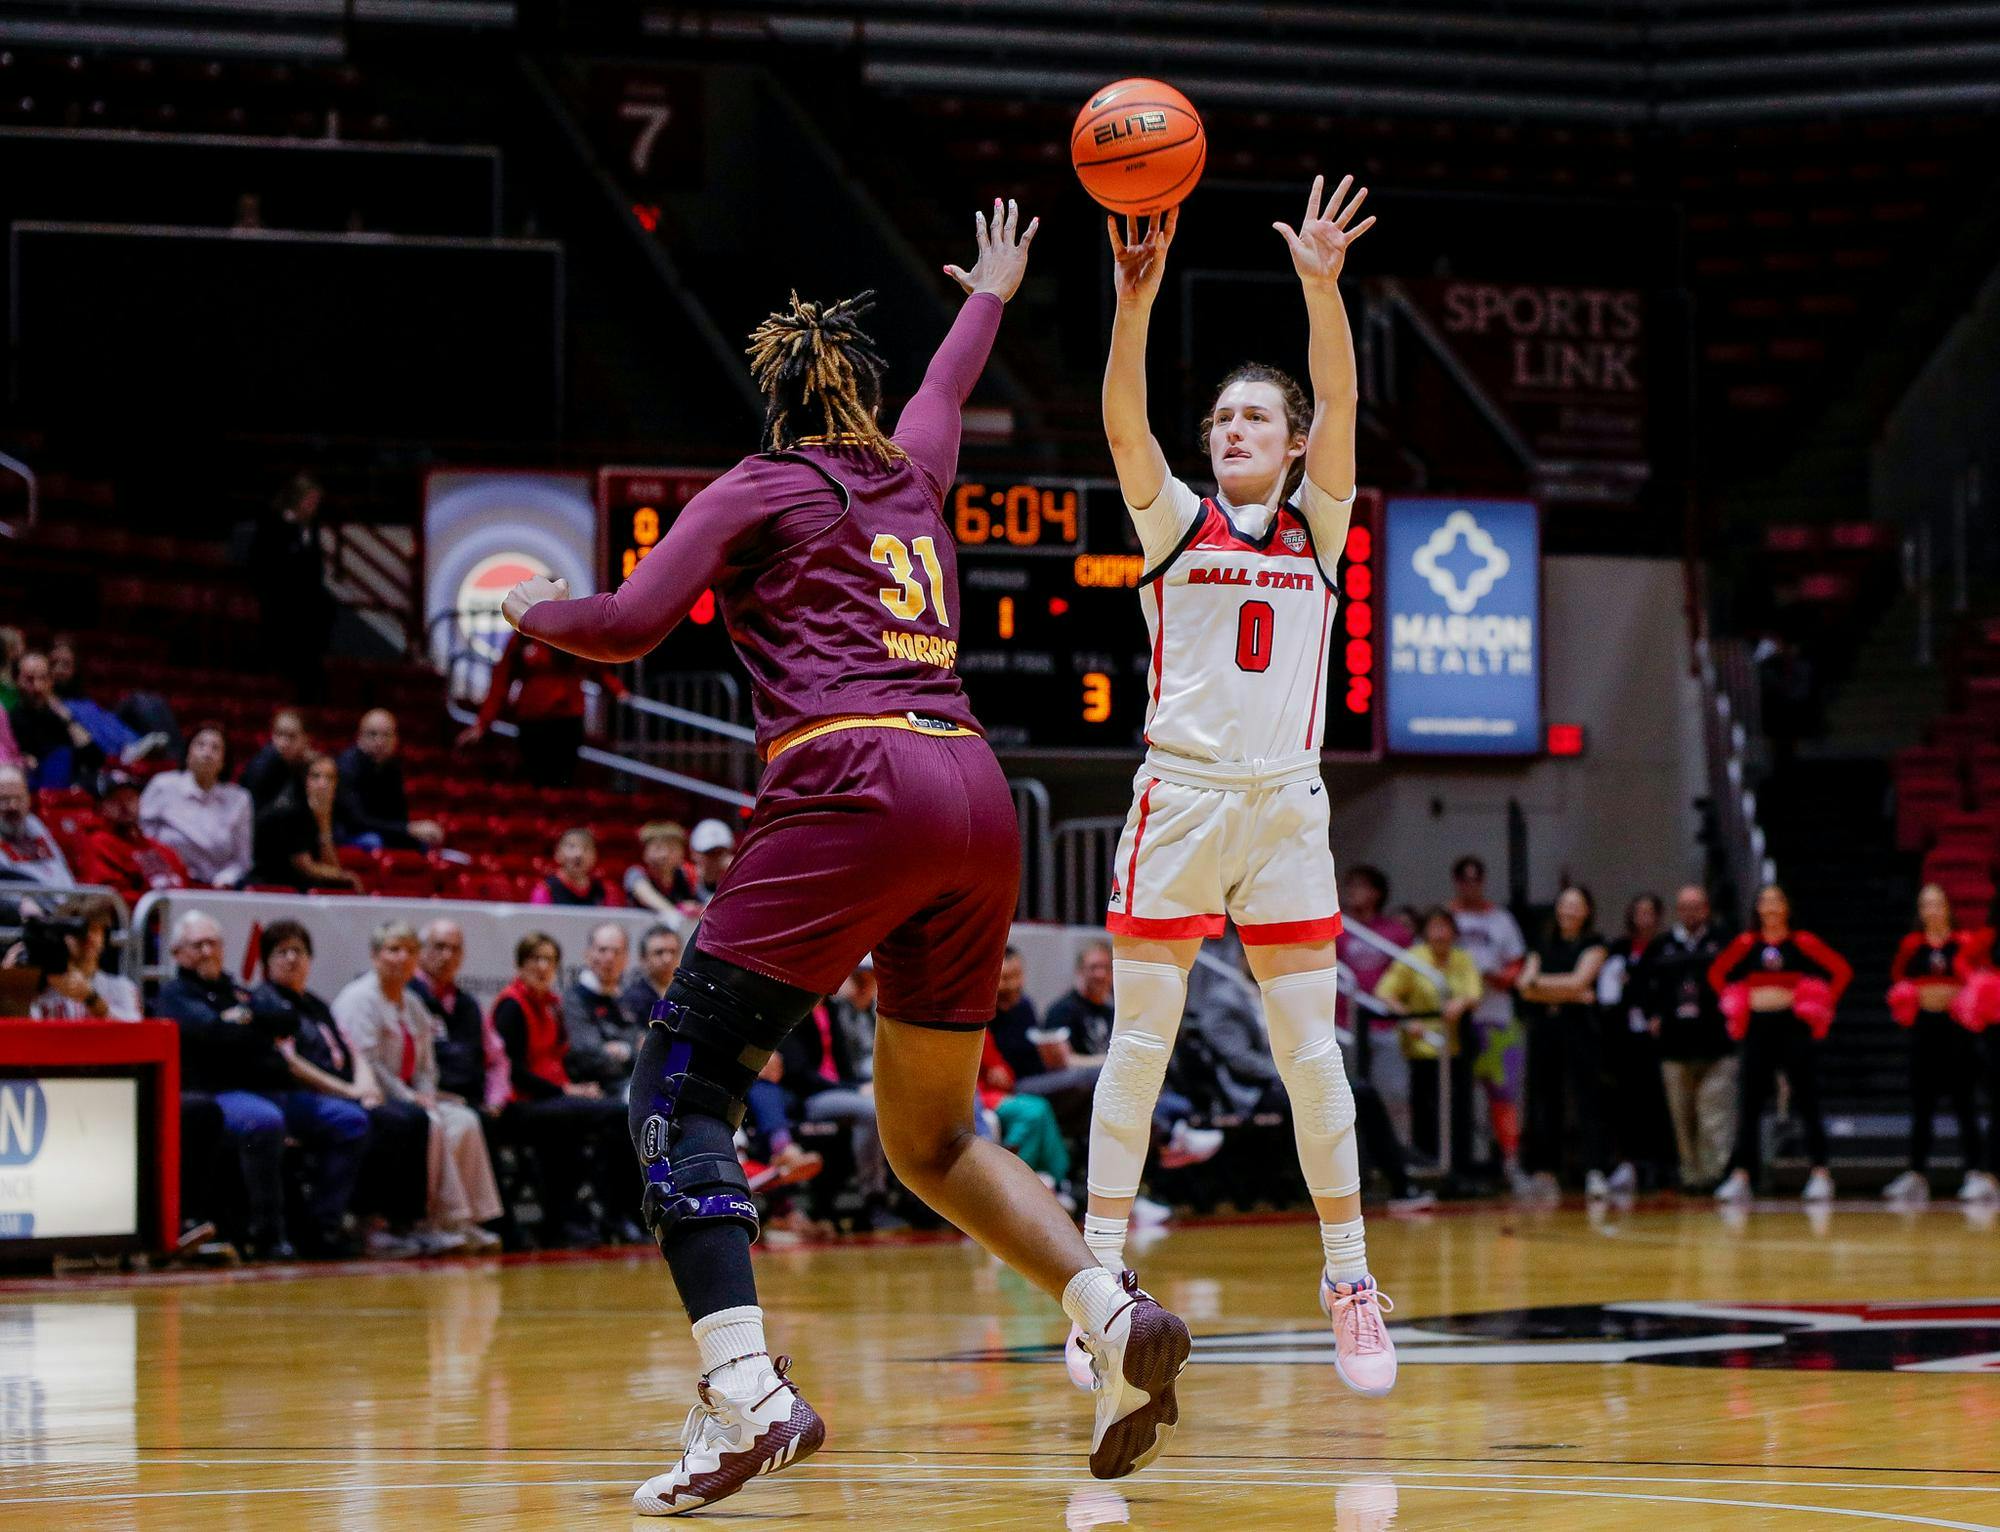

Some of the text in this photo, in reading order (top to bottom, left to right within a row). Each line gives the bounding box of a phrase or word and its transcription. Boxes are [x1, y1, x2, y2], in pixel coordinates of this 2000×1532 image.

[617, 102, 670, 171] 7
[1093, 111, 1167, 146] ELITE
[1444, 284, 1641, 338] SPORTS
[1511, 340, 1639, 390] LINK
[954, 482, 1079, 545] 6:04
[870, 533, 950, 628] 31
[1187, 567, 1314, 591] BALL STATE
[997, 596, 1015, 639] 1
[1234, 599, 1275, 673] 0
[1391, 613, 1533, 651] MARION
[882, 630, 958, 670] NORRIS
[1390, 650, 1533, 676] HEALTH
[1081, 671, 1112, 723] 3
